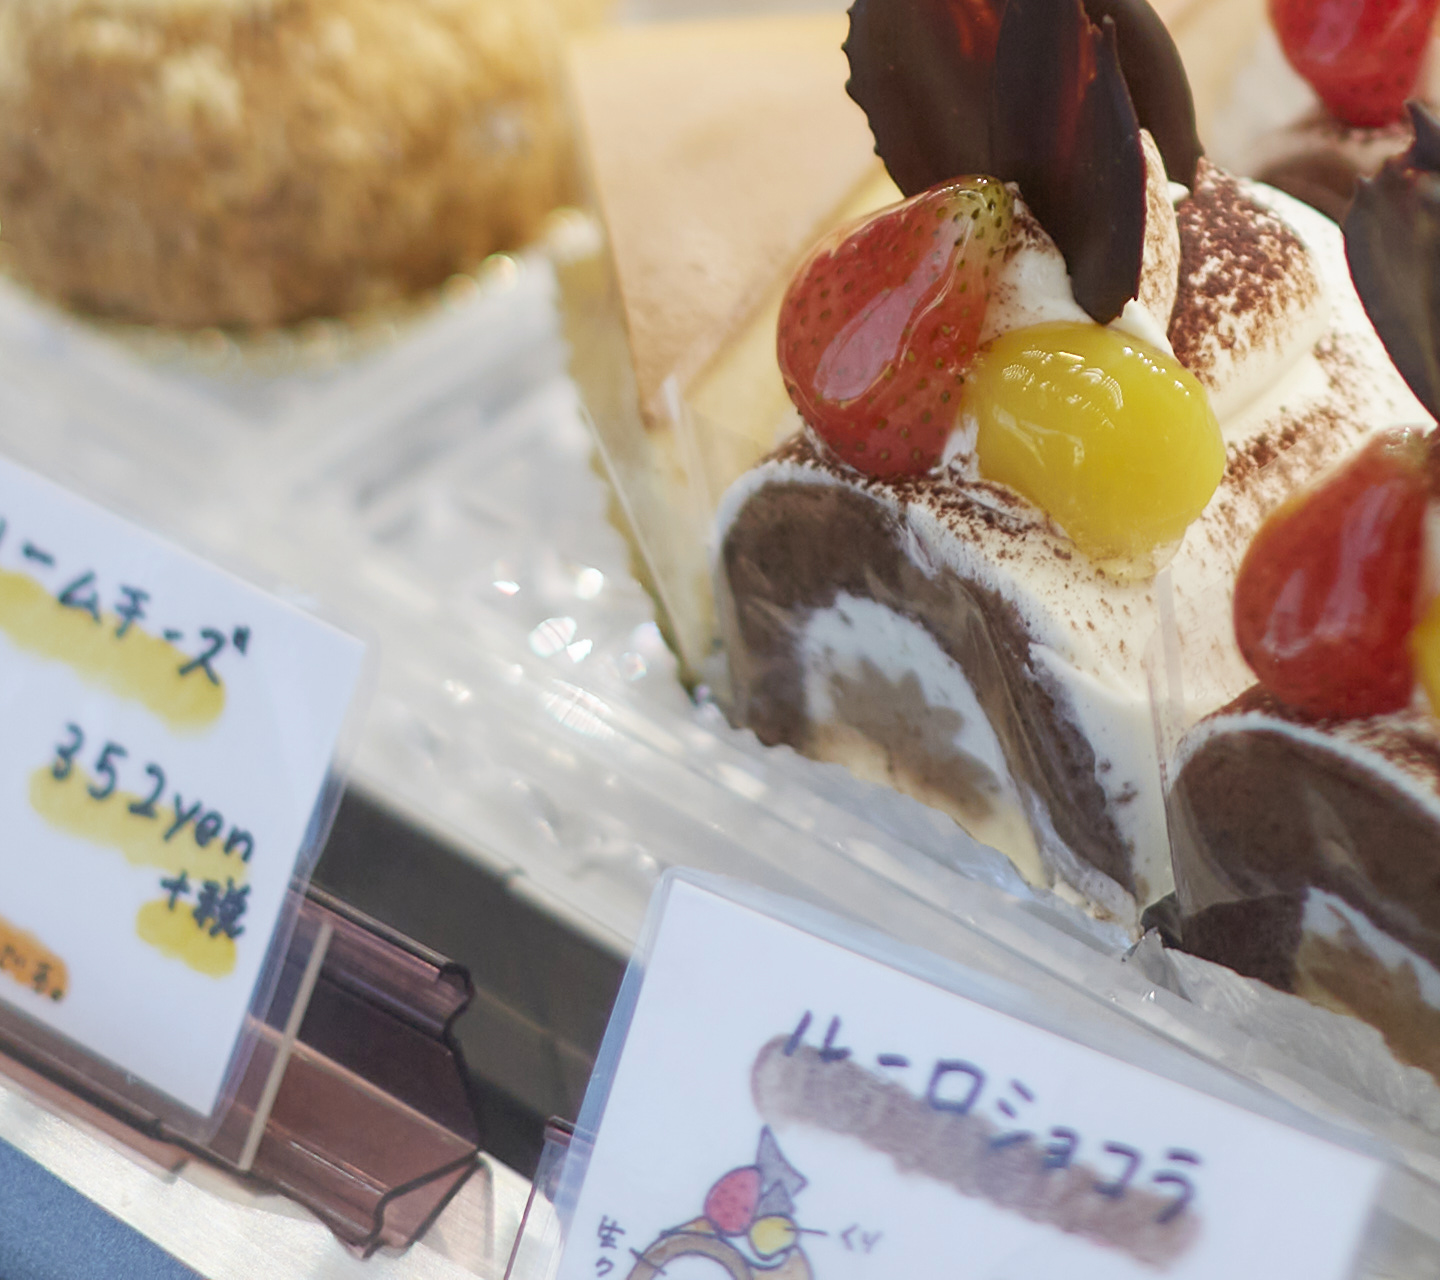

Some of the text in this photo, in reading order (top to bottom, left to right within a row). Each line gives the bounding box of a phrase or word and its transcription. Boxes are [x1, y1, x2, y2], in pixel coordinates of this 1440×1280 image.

[50, 722, 255, 864] 352yen
[160, 875, 251, 941] +税
[782, 1008, 1205, 1227] ルーロショコラ
